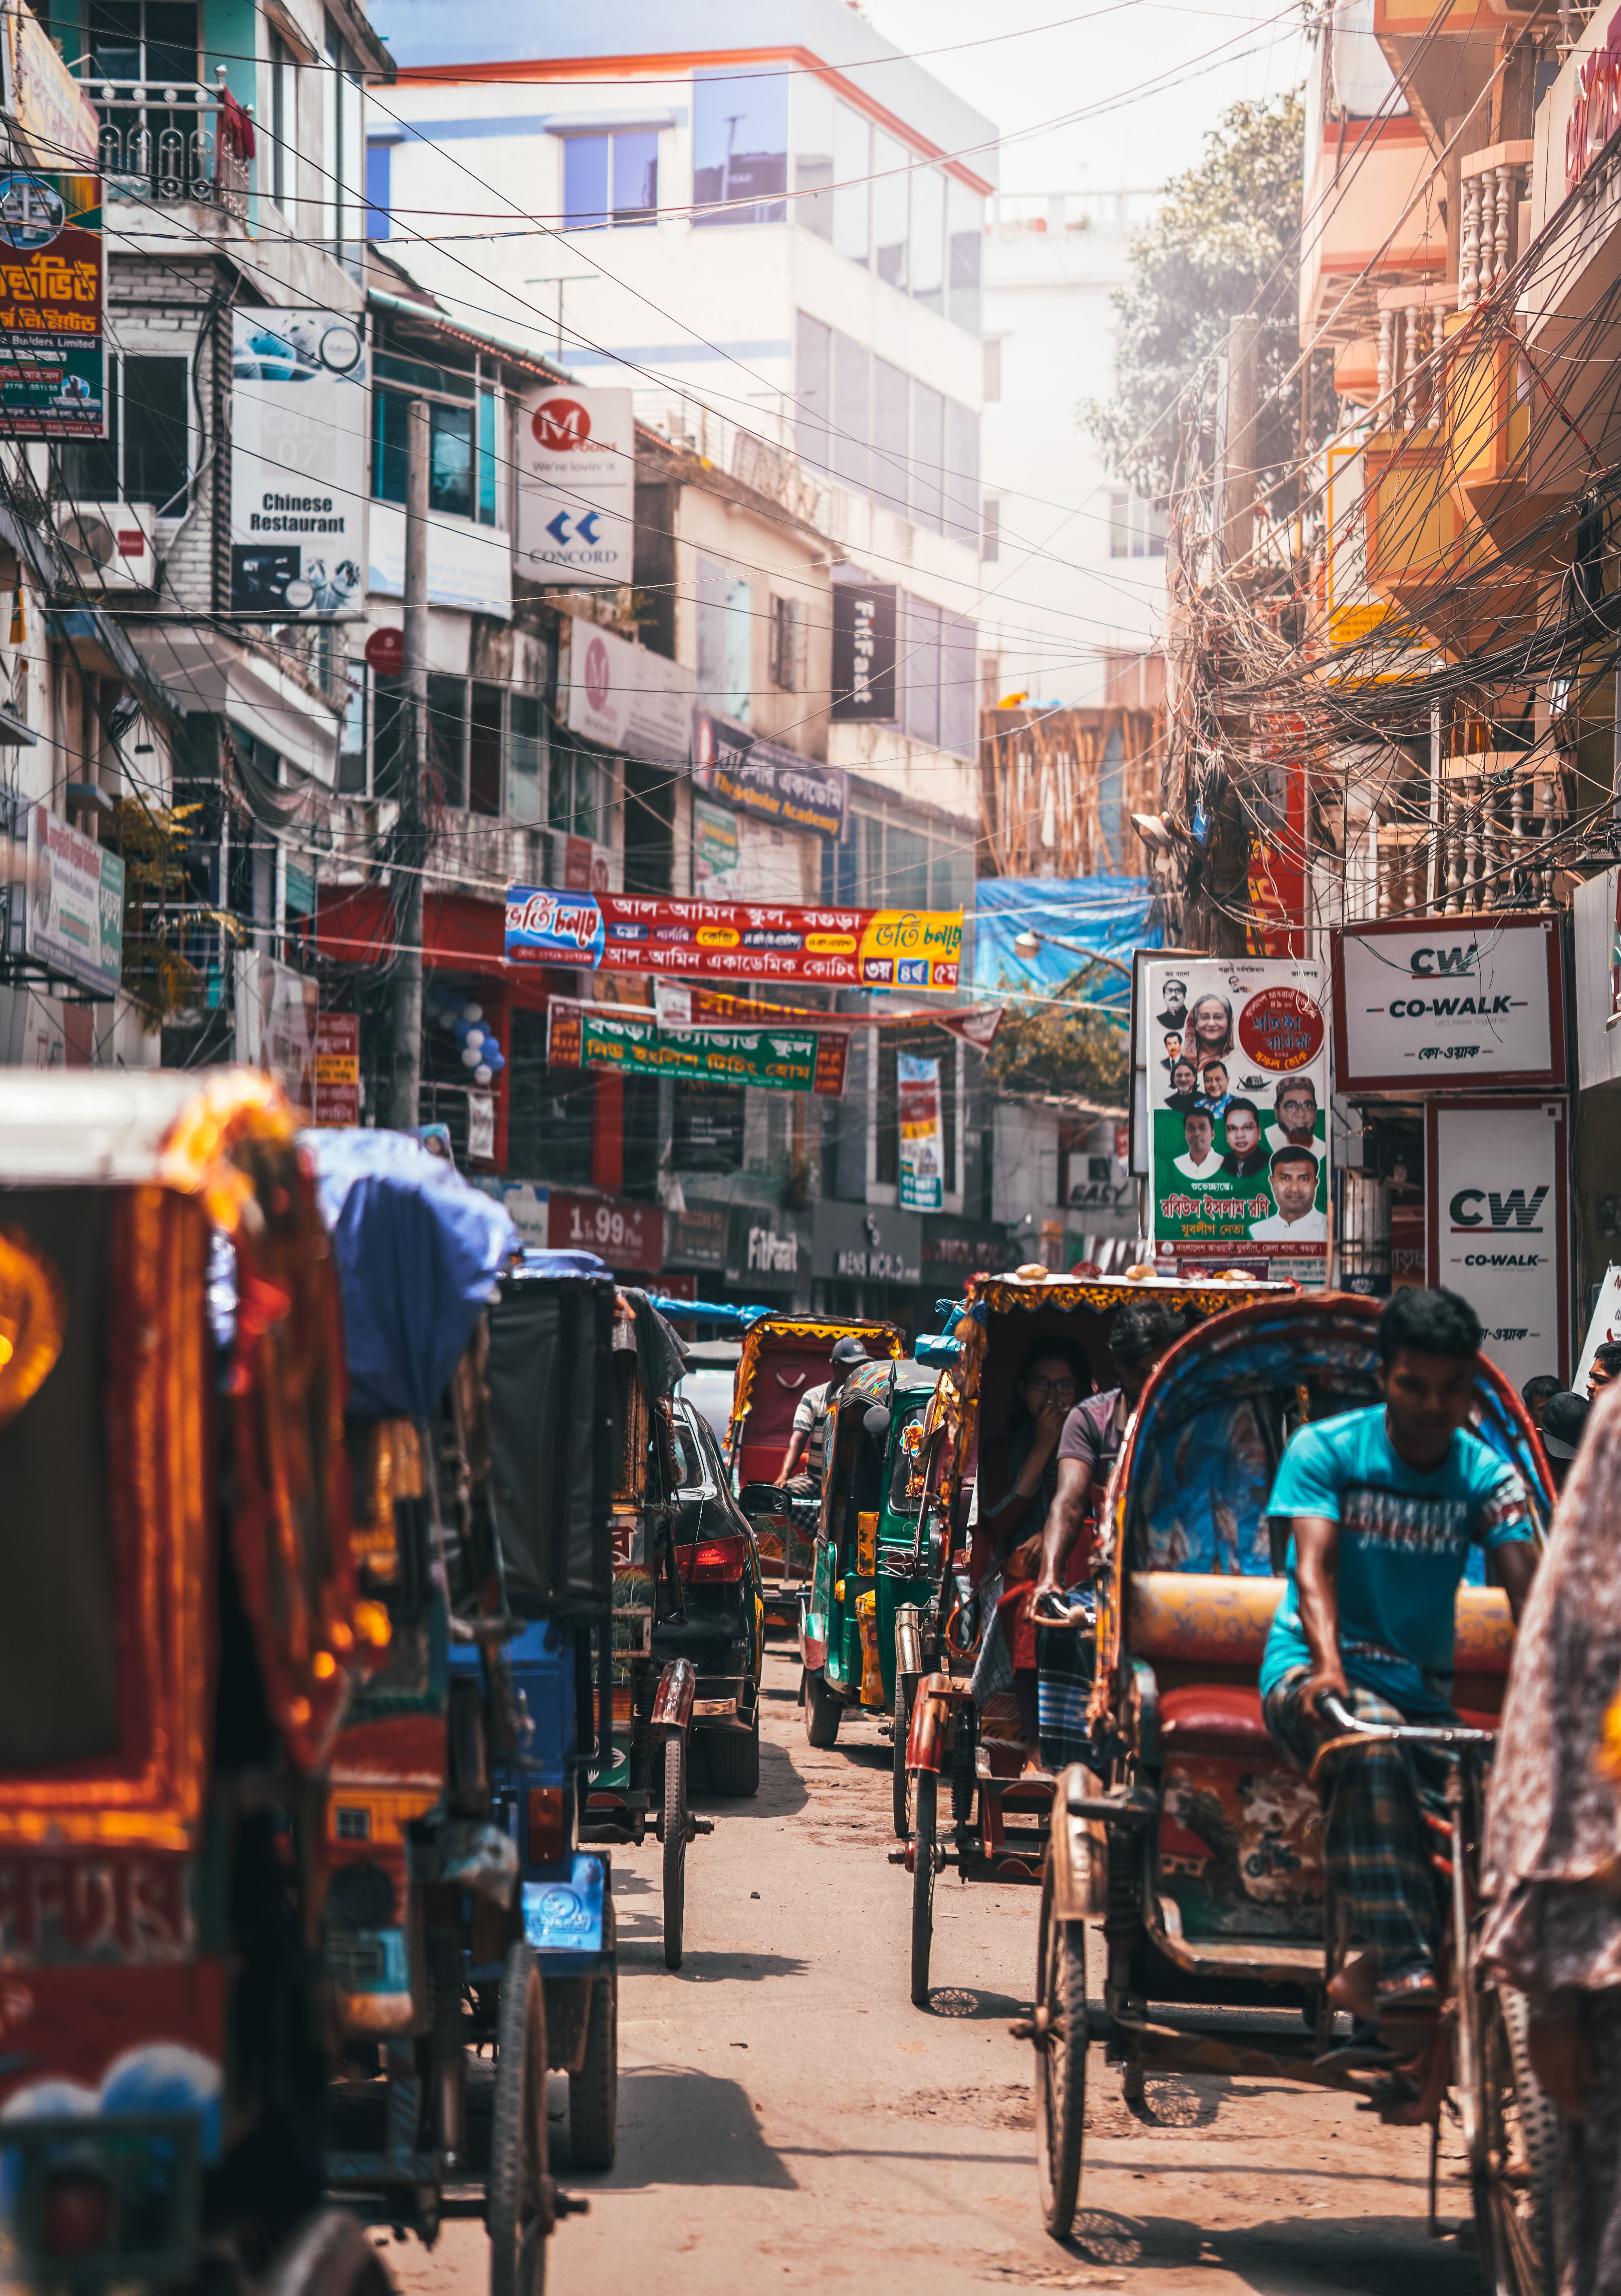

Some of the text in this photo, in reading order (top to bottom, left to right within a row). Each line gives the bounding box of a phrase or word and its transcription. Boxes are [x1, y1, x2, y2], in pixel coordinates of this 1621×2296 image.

[58, 337, 96, 349] Limited
[539, 409, 580, 441] M
[532, 461, 615, 472] We're lovin' it
[262, 493, 333, 513] Chinese
[250, 513, 345, 533] Restaurant
[529, 549, 618, 564] CONCORD
[611, 899, 862, 931] আল-আমিন স্কুল, বগুড়া
[876, 913, 923, 947] ভর্তি
[605, 946, 702, 968] আল-আমিন
[706, 951, 798, 973] একাডেমিক
[803, 955, 858, 980] কোচিং
[1411, 943, 1478, 973] CW
[1389, 995, 1512, 1018] CO-WALK
[1252, 1009, 1303, 1033] প্রতিষ্ঠা
[1435, 1018, 1451, 1027] Let's
[1475, 1017, 1507, 1025] Together
[1263, 1032, 1312, 1051] বার্ষিকী
[1418, 1045, 1481, 1060] কো-ওয়াক
[1160, 1193, 1203, 1220] রবিউল
[1203, 1193, 1247, 1221] ইসলাম
[1449, 1185, 1550, 1226] CW
[595, 1206, 624, 1245] 99
[1180, 1220, 1245, 1238] যুবলীগ নেতা
[1176, 1243, 1206, 1253] বাংলাদেশ
[1262, 1244, 1279, 1253] জেলা
[1465, 1254, 1540, 1267] CO-WALK
